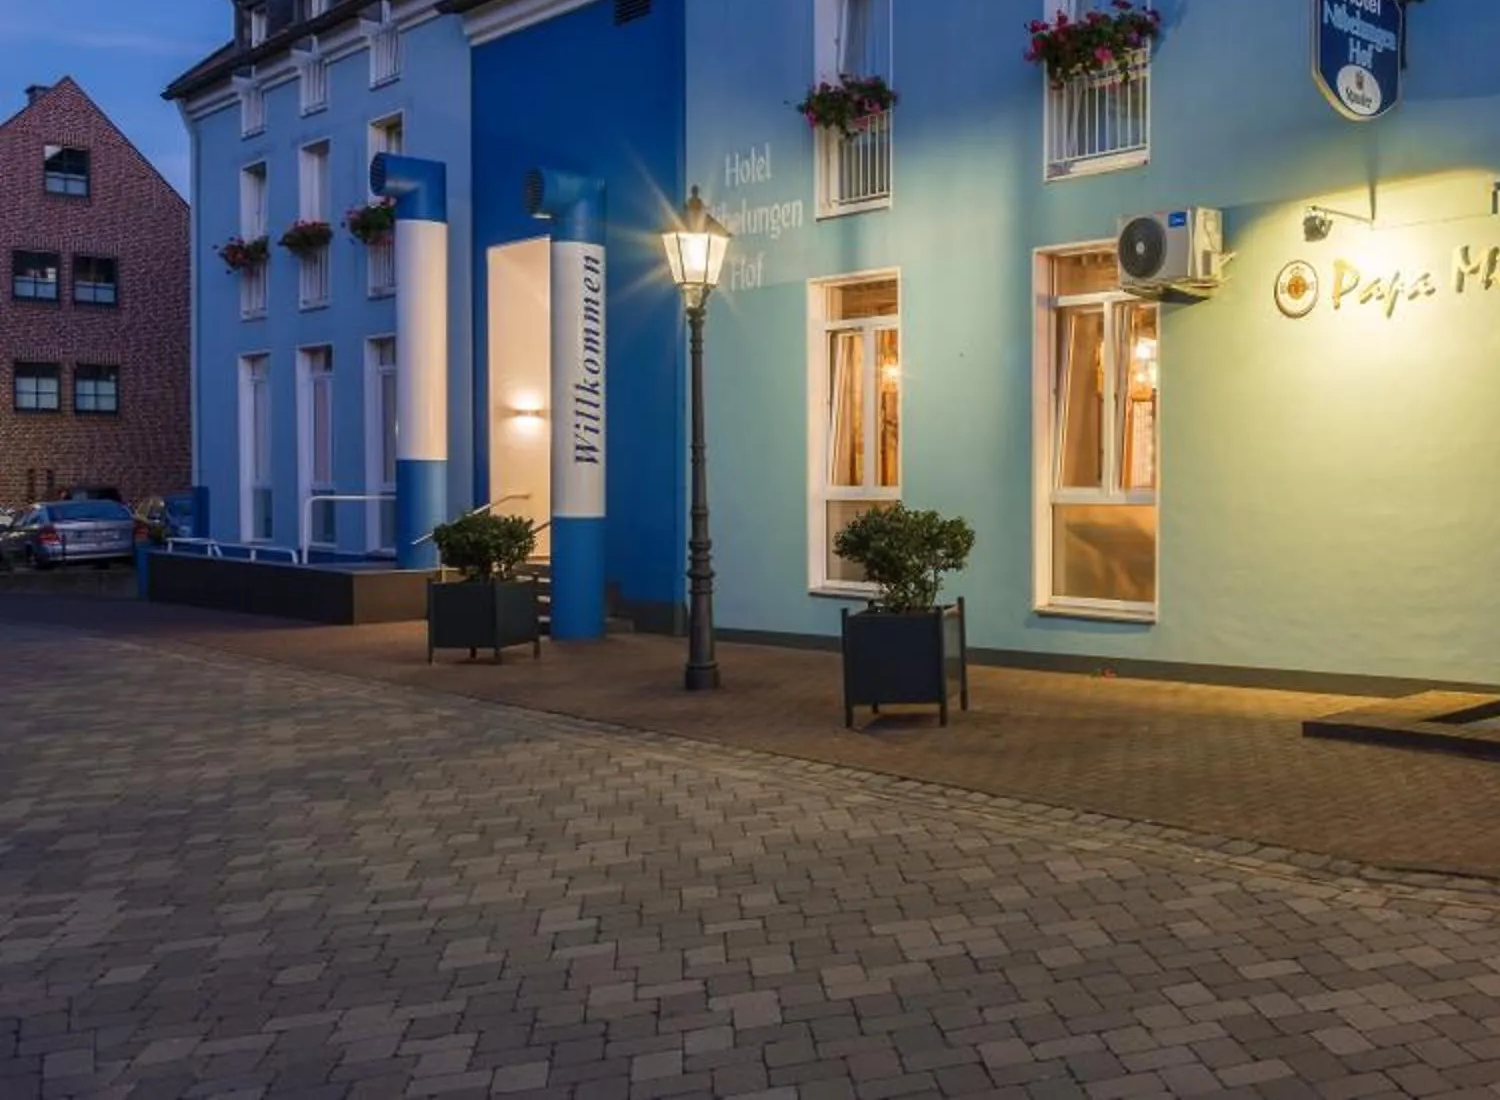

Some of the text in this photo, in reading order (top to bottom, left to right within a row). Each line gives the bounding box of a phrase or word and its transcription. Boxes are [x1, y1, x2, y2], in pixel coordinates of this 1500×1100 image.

[725, 143, 771, 187] Hotel
[731, 251, 767, 291] Hof
[573, 253, 602, 465] Willkommen
